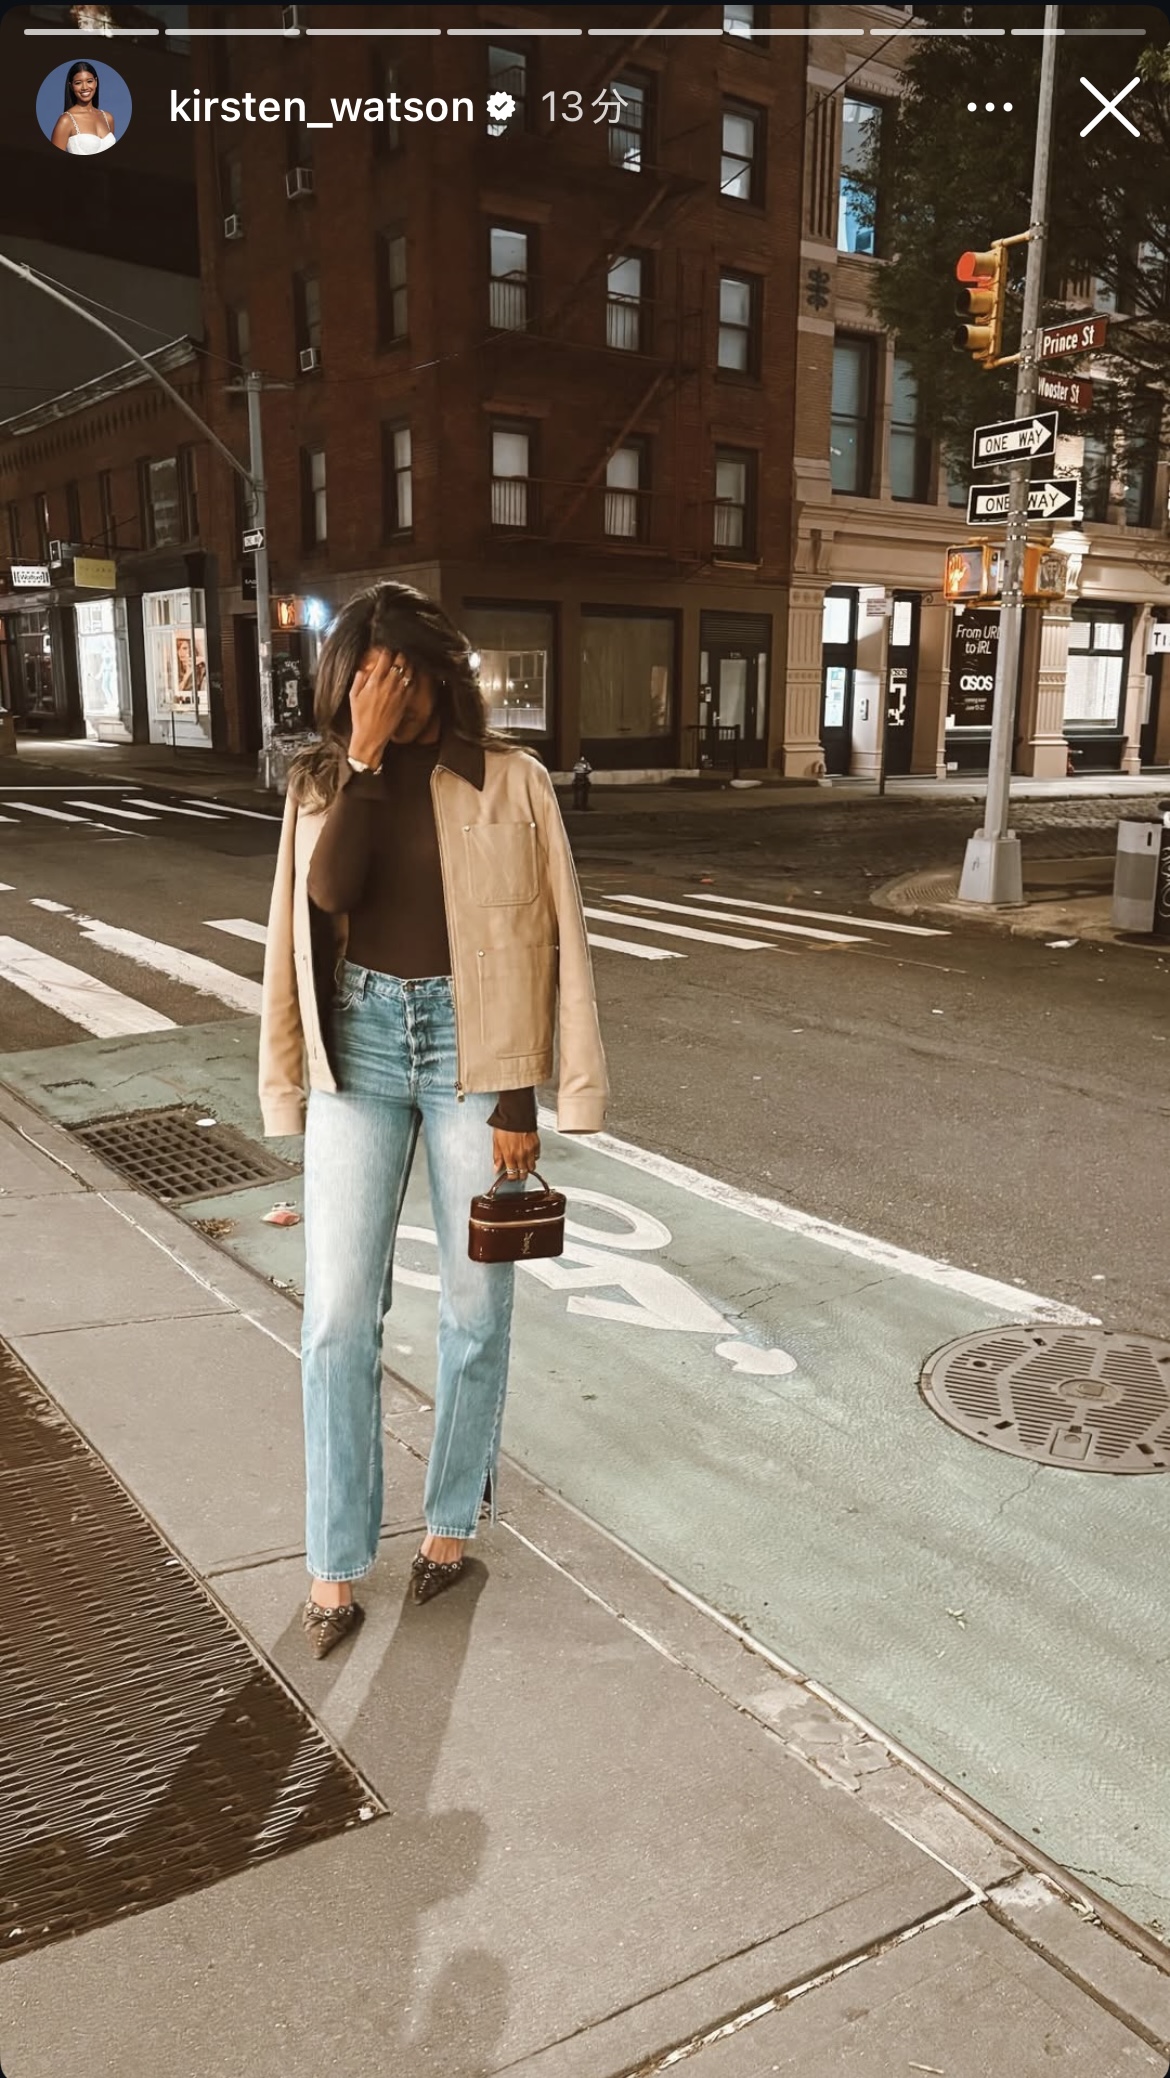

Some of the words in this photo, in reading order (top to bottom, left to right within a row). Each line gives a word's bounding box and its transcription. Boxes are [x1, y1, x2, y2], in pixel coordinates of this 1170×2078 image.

[1043, 333, 1078, 356] Prince
[1081, 325, 1095, 347] St
[1038, 377, 1068, 401] Wooster
[1070, 384, 1080, 404] St
[985, 435, 1008, 454] ONE
[1019, 428, 1044, 448] WAY
[986, 496, 1010, 512] ONE
[1028, 493, 1059, 509] WAY
[956, 624, 982, 639] From
[965, 641, 977, 654] to
[977, 640, 992, 655] IRL
[960, 675, 993, 691] asos
